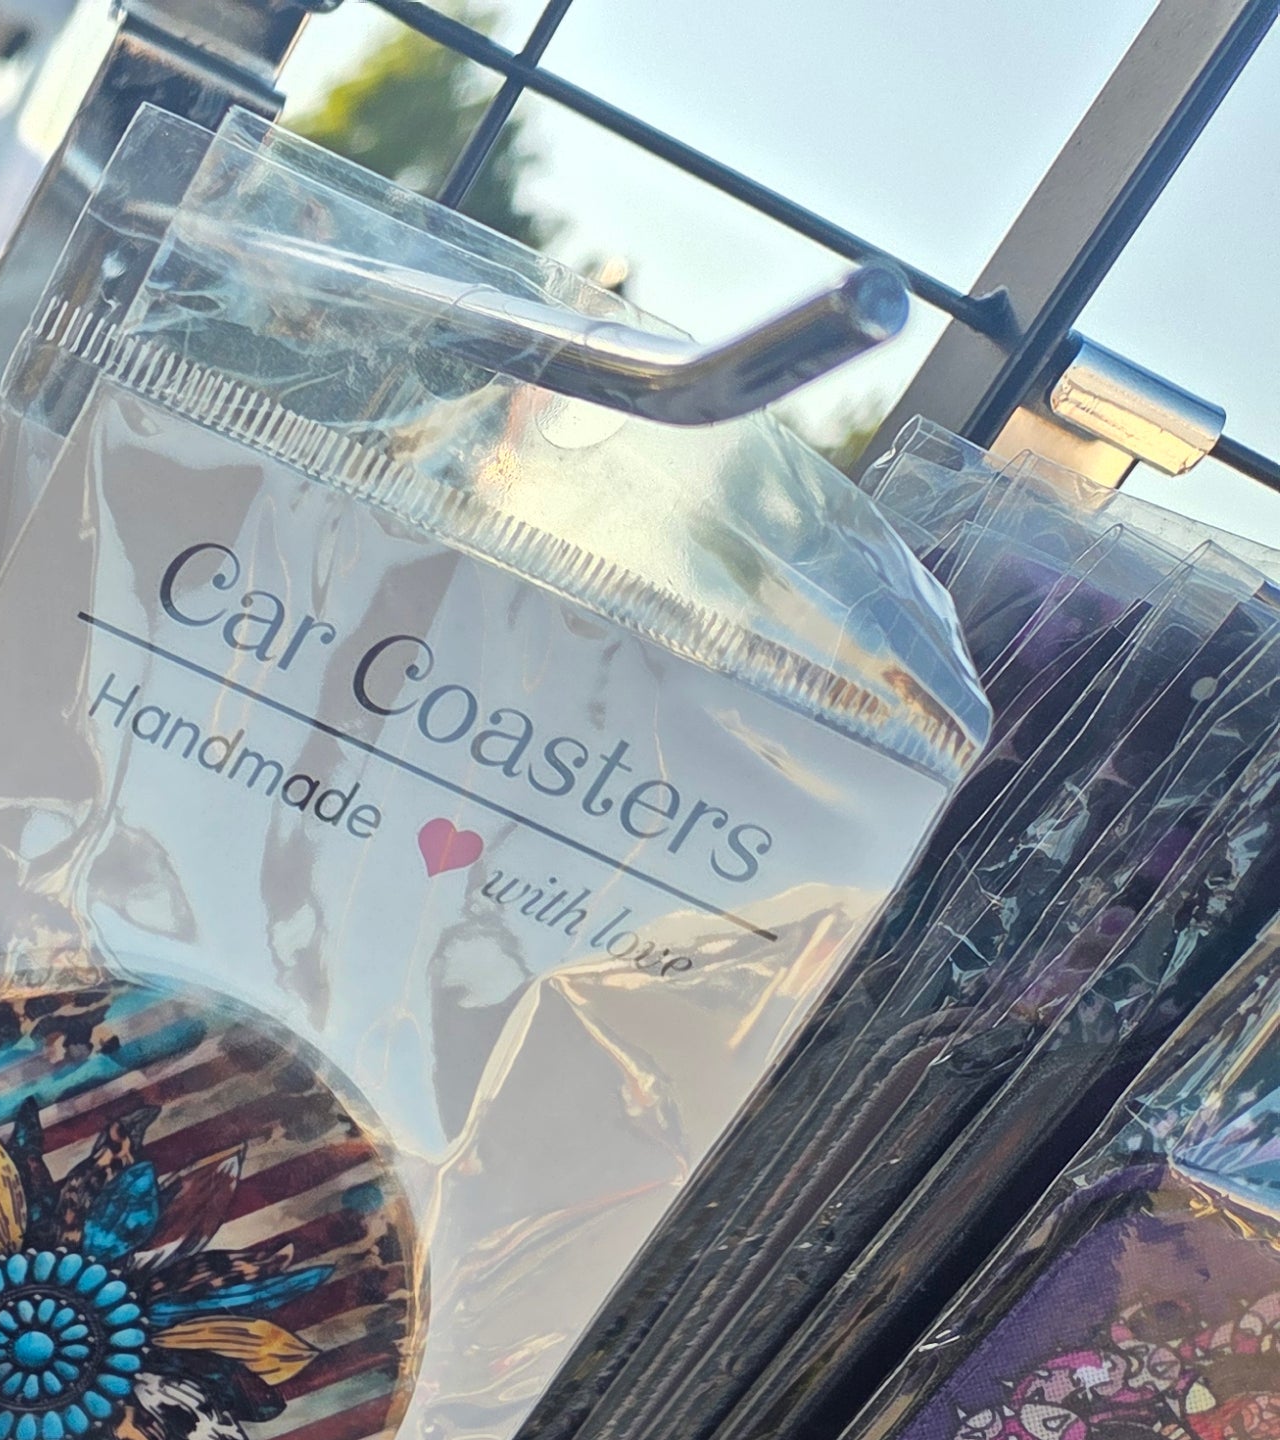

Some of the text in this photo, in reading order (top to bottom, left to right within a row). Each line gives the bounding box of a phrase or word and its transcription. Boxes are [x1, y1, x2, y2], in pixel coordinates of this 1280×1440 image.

[87, 672, 384, 840] Handmade
[157, 541, 775, 884] Car Coasters
[482, 857, 695, 978] with love
